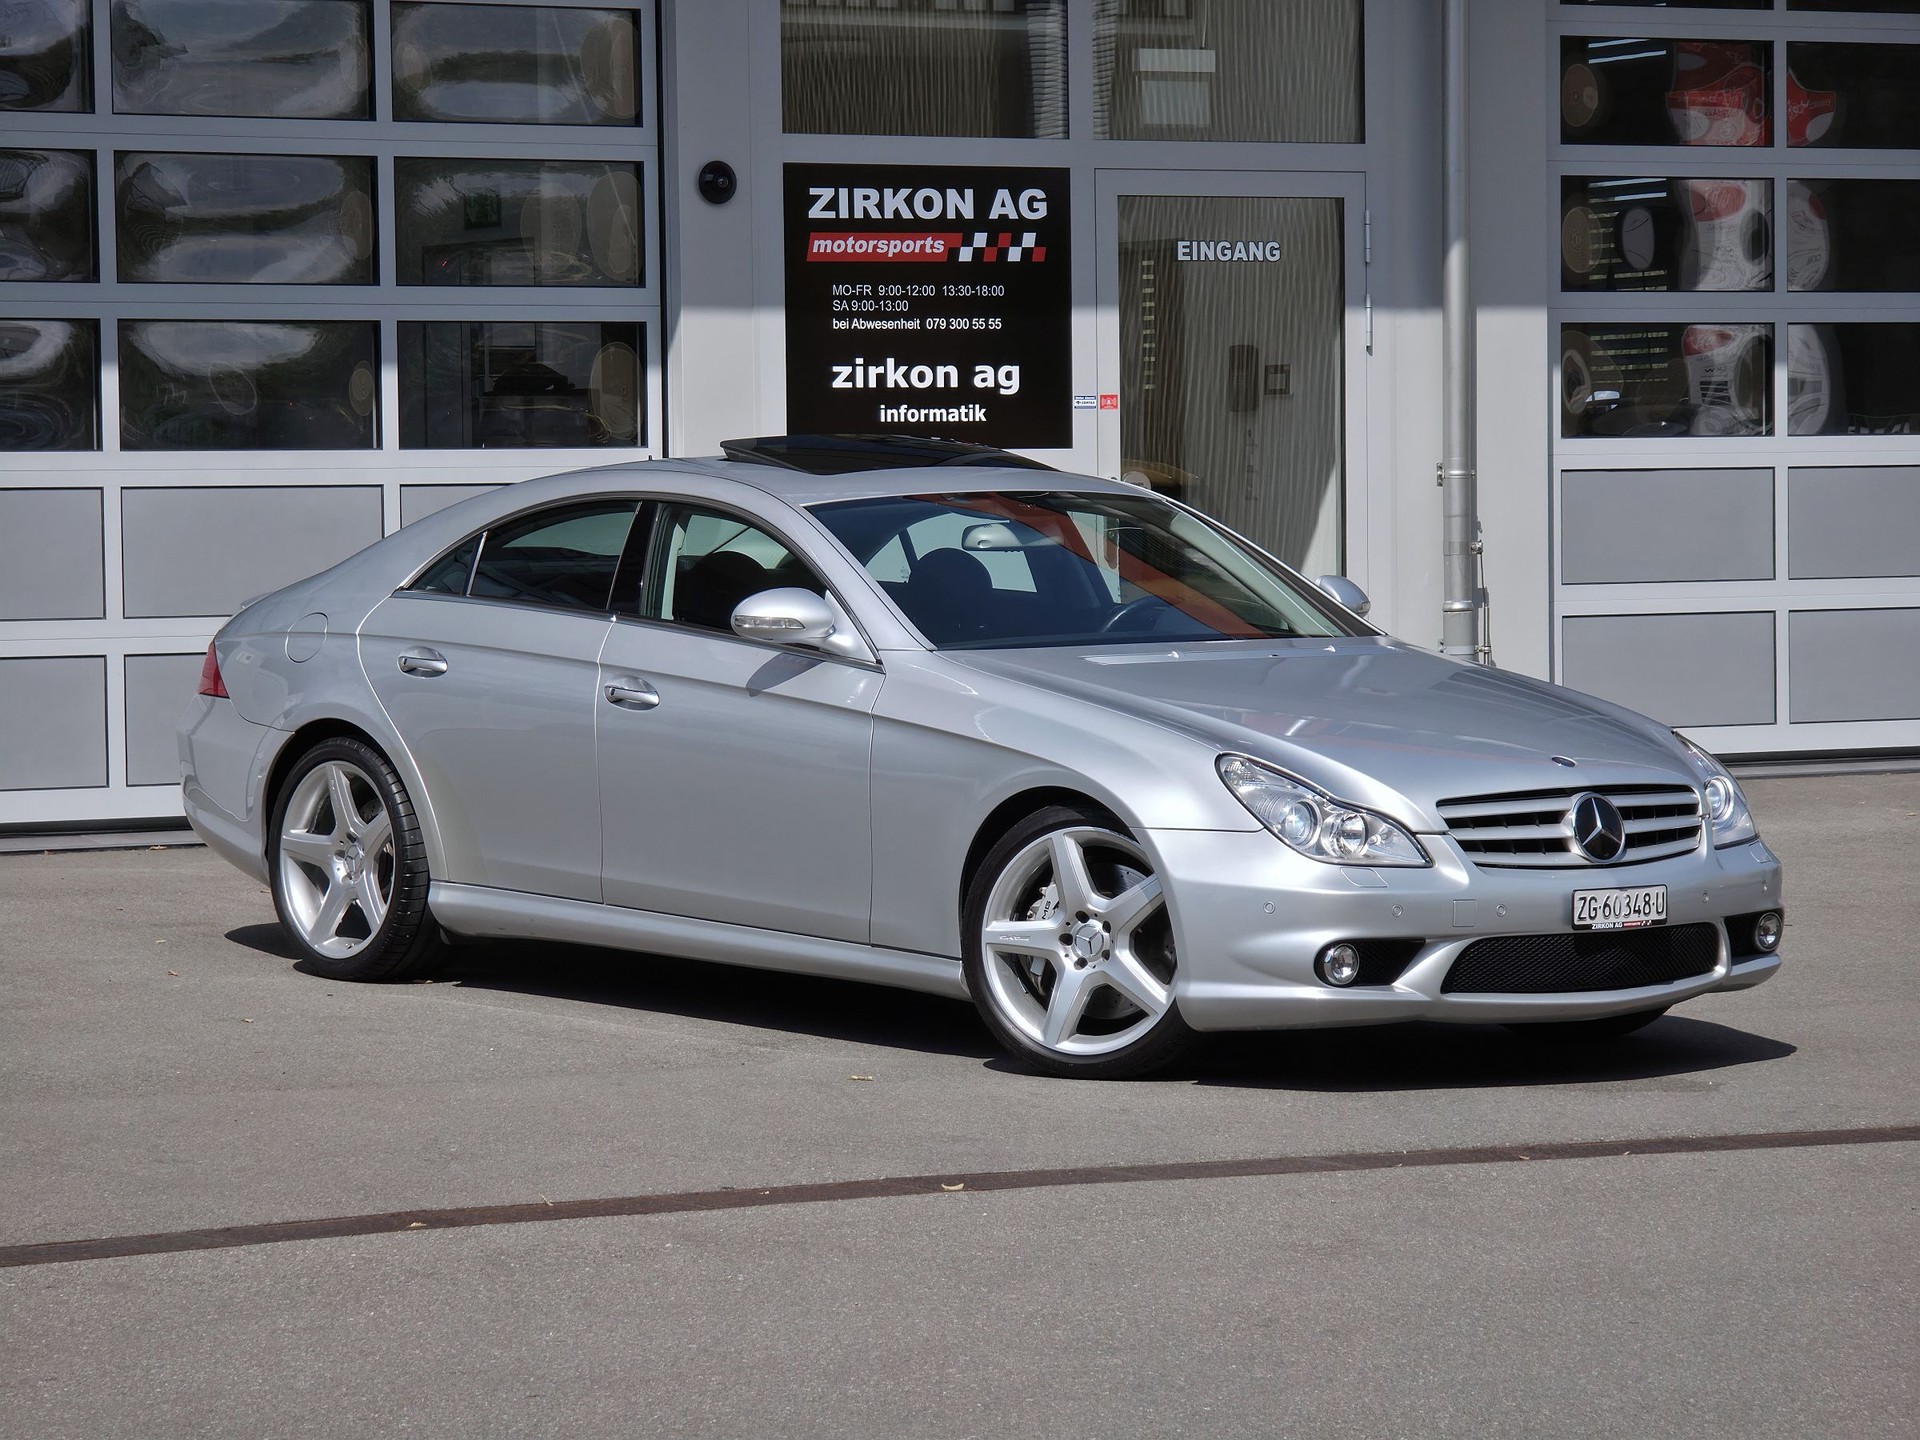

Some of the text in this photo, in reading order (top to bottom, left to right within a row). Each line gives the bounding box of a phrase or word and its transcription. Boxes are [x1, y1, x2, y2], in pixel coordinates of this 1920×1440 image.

[808, 187, 1048, 220] ZIRKON AG
[812, 236, 945, 258] motorsports
[1177, 241, 1281, 262] EINGANG
[832, 284, 1005, 297] MO-FR 9:00-12:00 13:30-18:00
[832, 299, 909, 312] SA 9:00-13:00
[832, 317, 1003, 330] bei Abwesenheit 079 300 55 55
[831, 357, 1020, 396] zirkon ag
[879, 403, 987, 423] informatik
[1591, 922, 1614, 930] ZIRKON
[1614, 921, 1623, 929] AG
